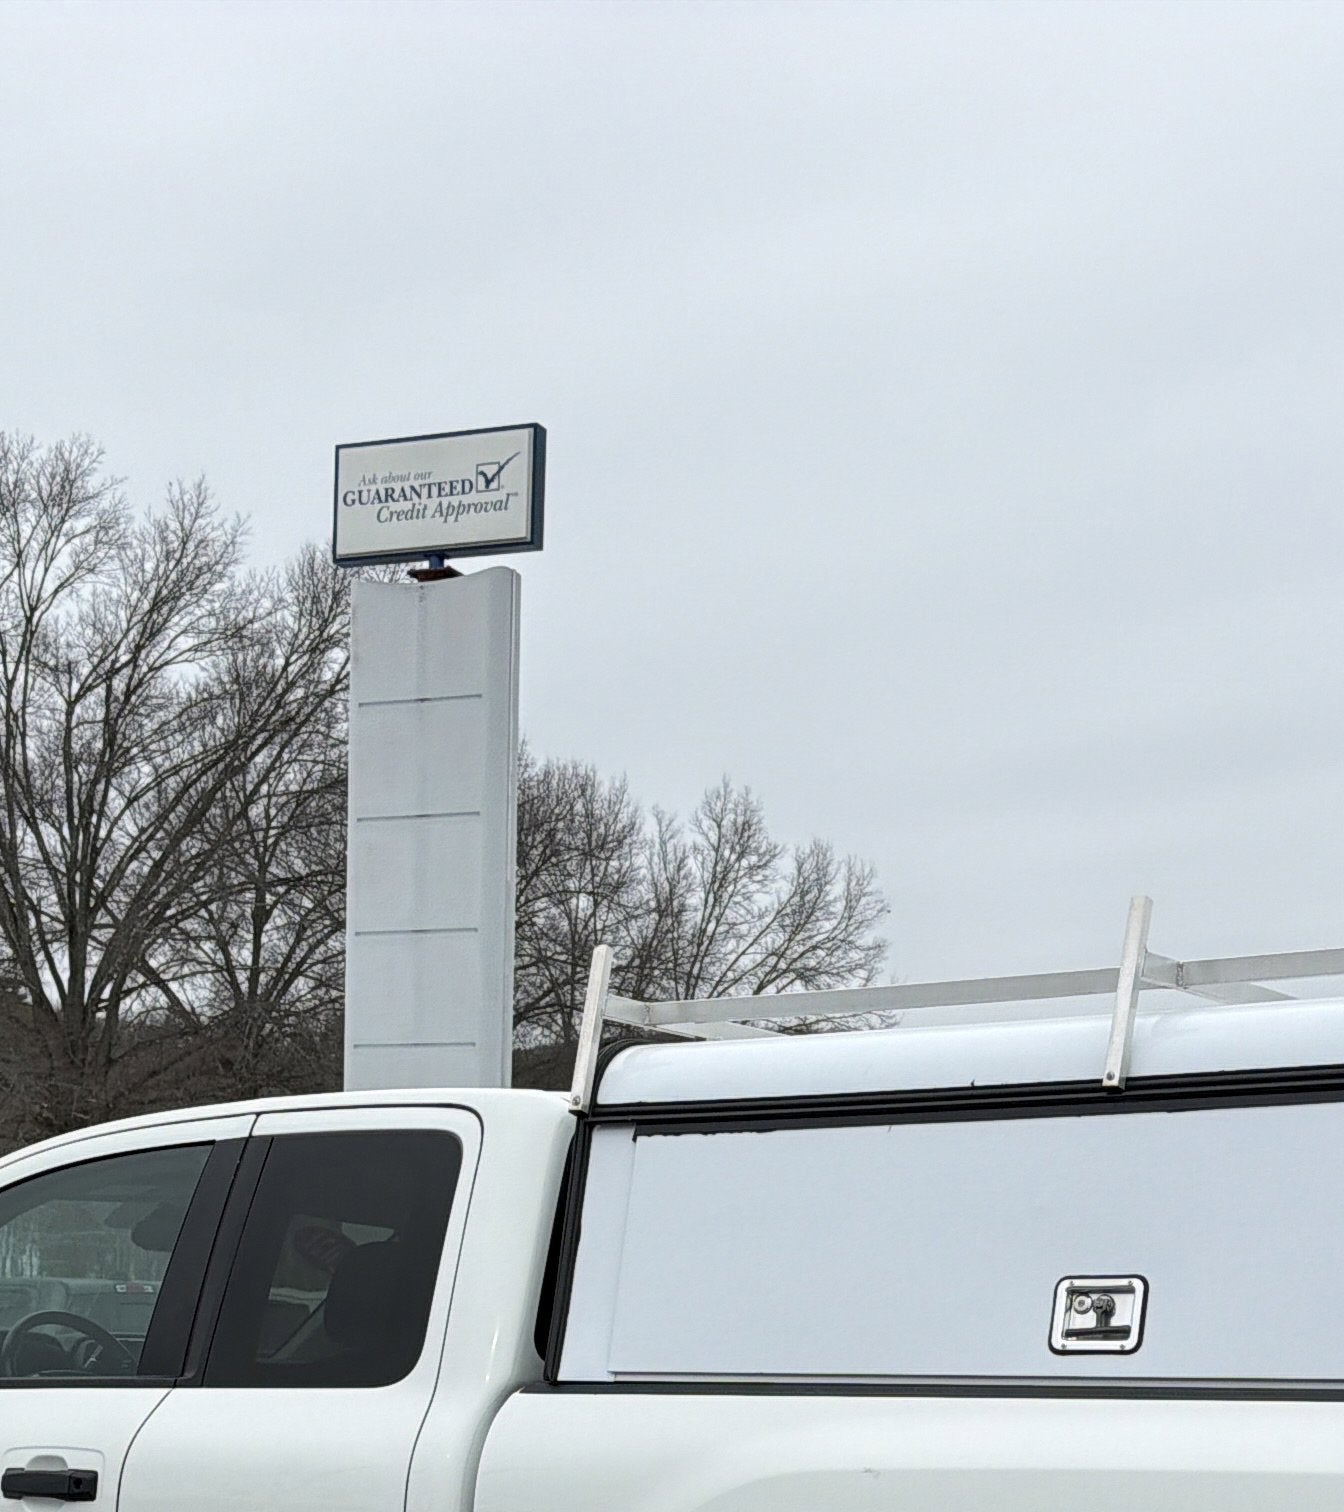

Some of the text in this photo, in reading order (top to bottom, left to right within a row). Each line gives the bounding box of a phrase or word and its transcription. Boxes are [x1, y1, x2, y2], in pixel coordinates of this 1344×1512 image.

[342, 478, 474, 507] GUARANTEED
[359, 470, 433, 487] Ask about our
[376, 492, 512, 524] Credit Approval
